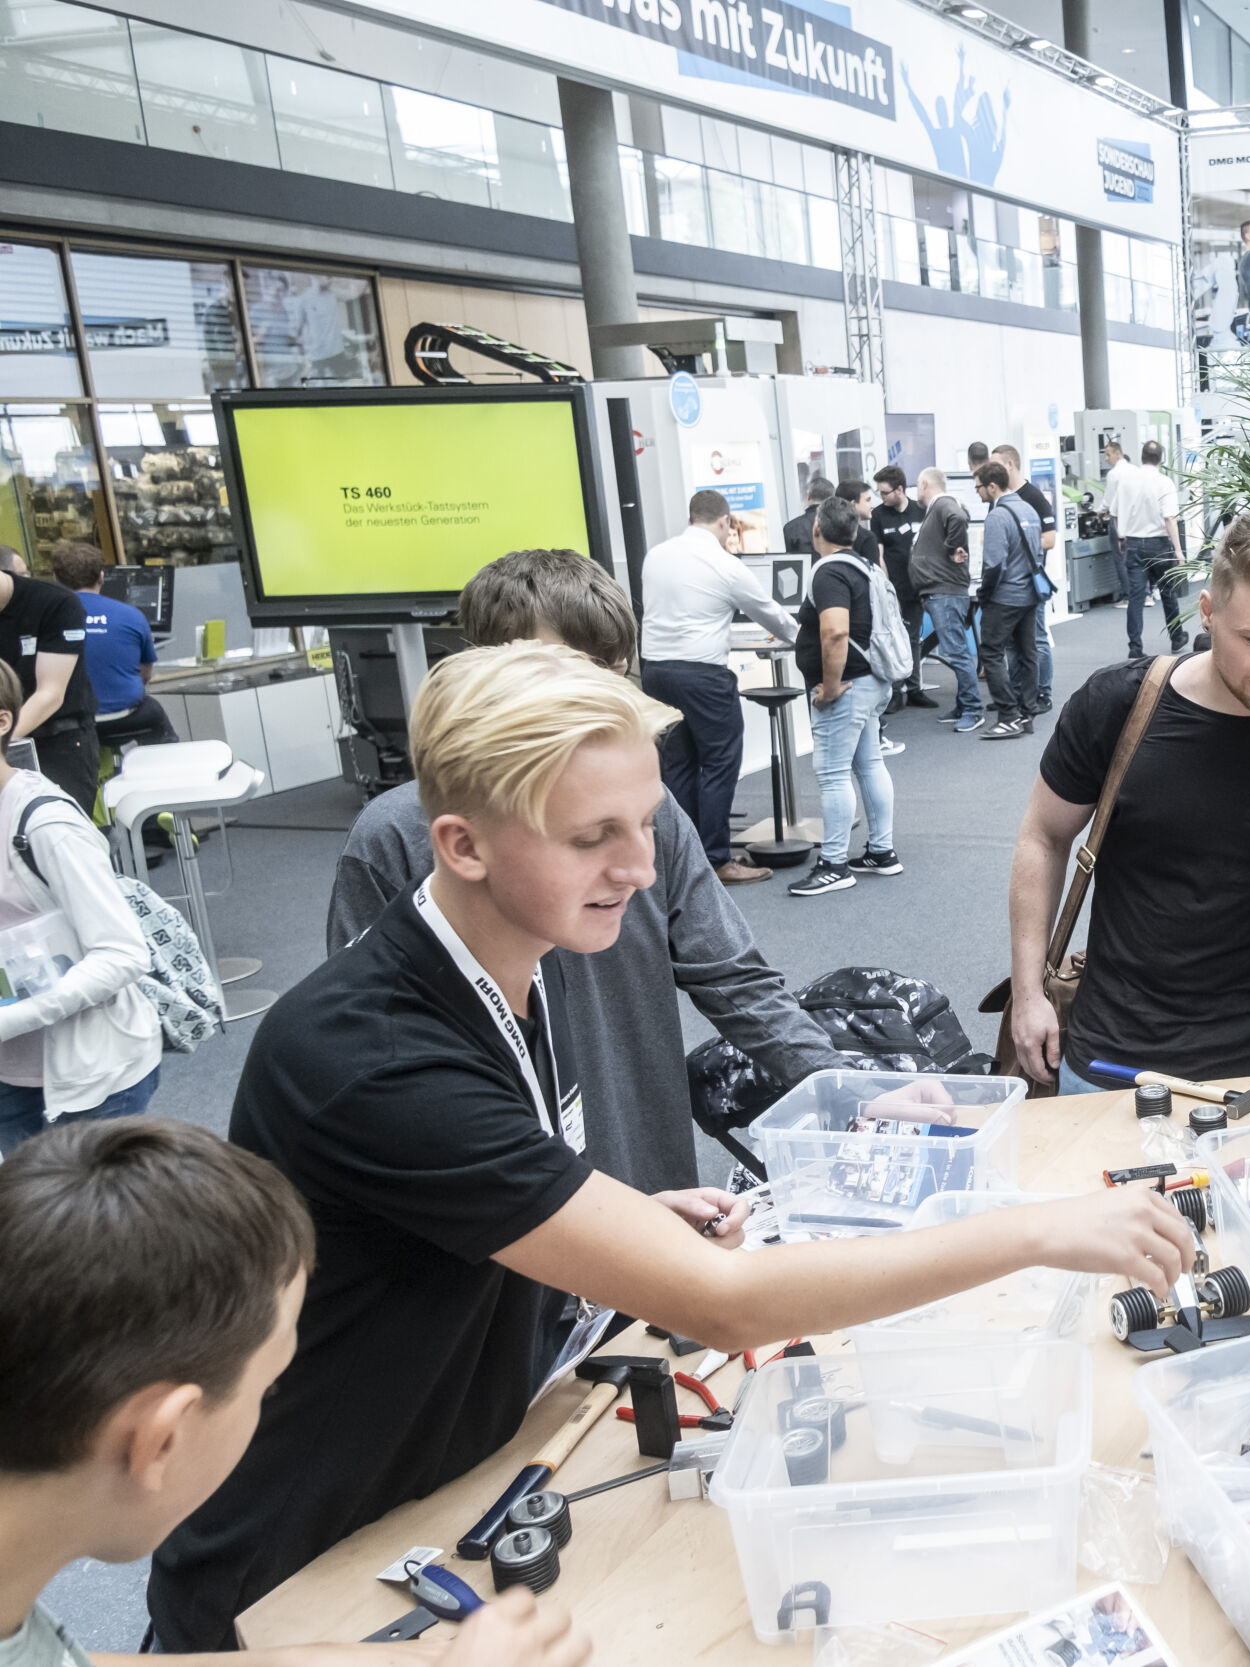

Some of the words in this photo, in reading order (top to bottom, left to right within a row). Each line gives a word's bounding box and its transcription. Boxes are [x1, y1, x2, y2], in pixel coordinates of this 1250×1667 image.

[691, 0, 757, 59] mit
[761, 7, 889, 106] Zukunft
[1098, 141, 1154, 182] SONDERSCHAU
[1209, 157, 1234, 167] DMG
[1104, 168, 1135, 198] JUGEND
[340, 487, 361, 500] TS
[365, 486, 392, 499] 460
[343, 503, 365, 515] Das
[345, 517, 363, 528] der
[366, 517, 418, 527] neuesten
[420, 514, 481, 526] Generation
[474, 976, 508, 1018] MORI
[504, 1018, 526, 1059] DMG
